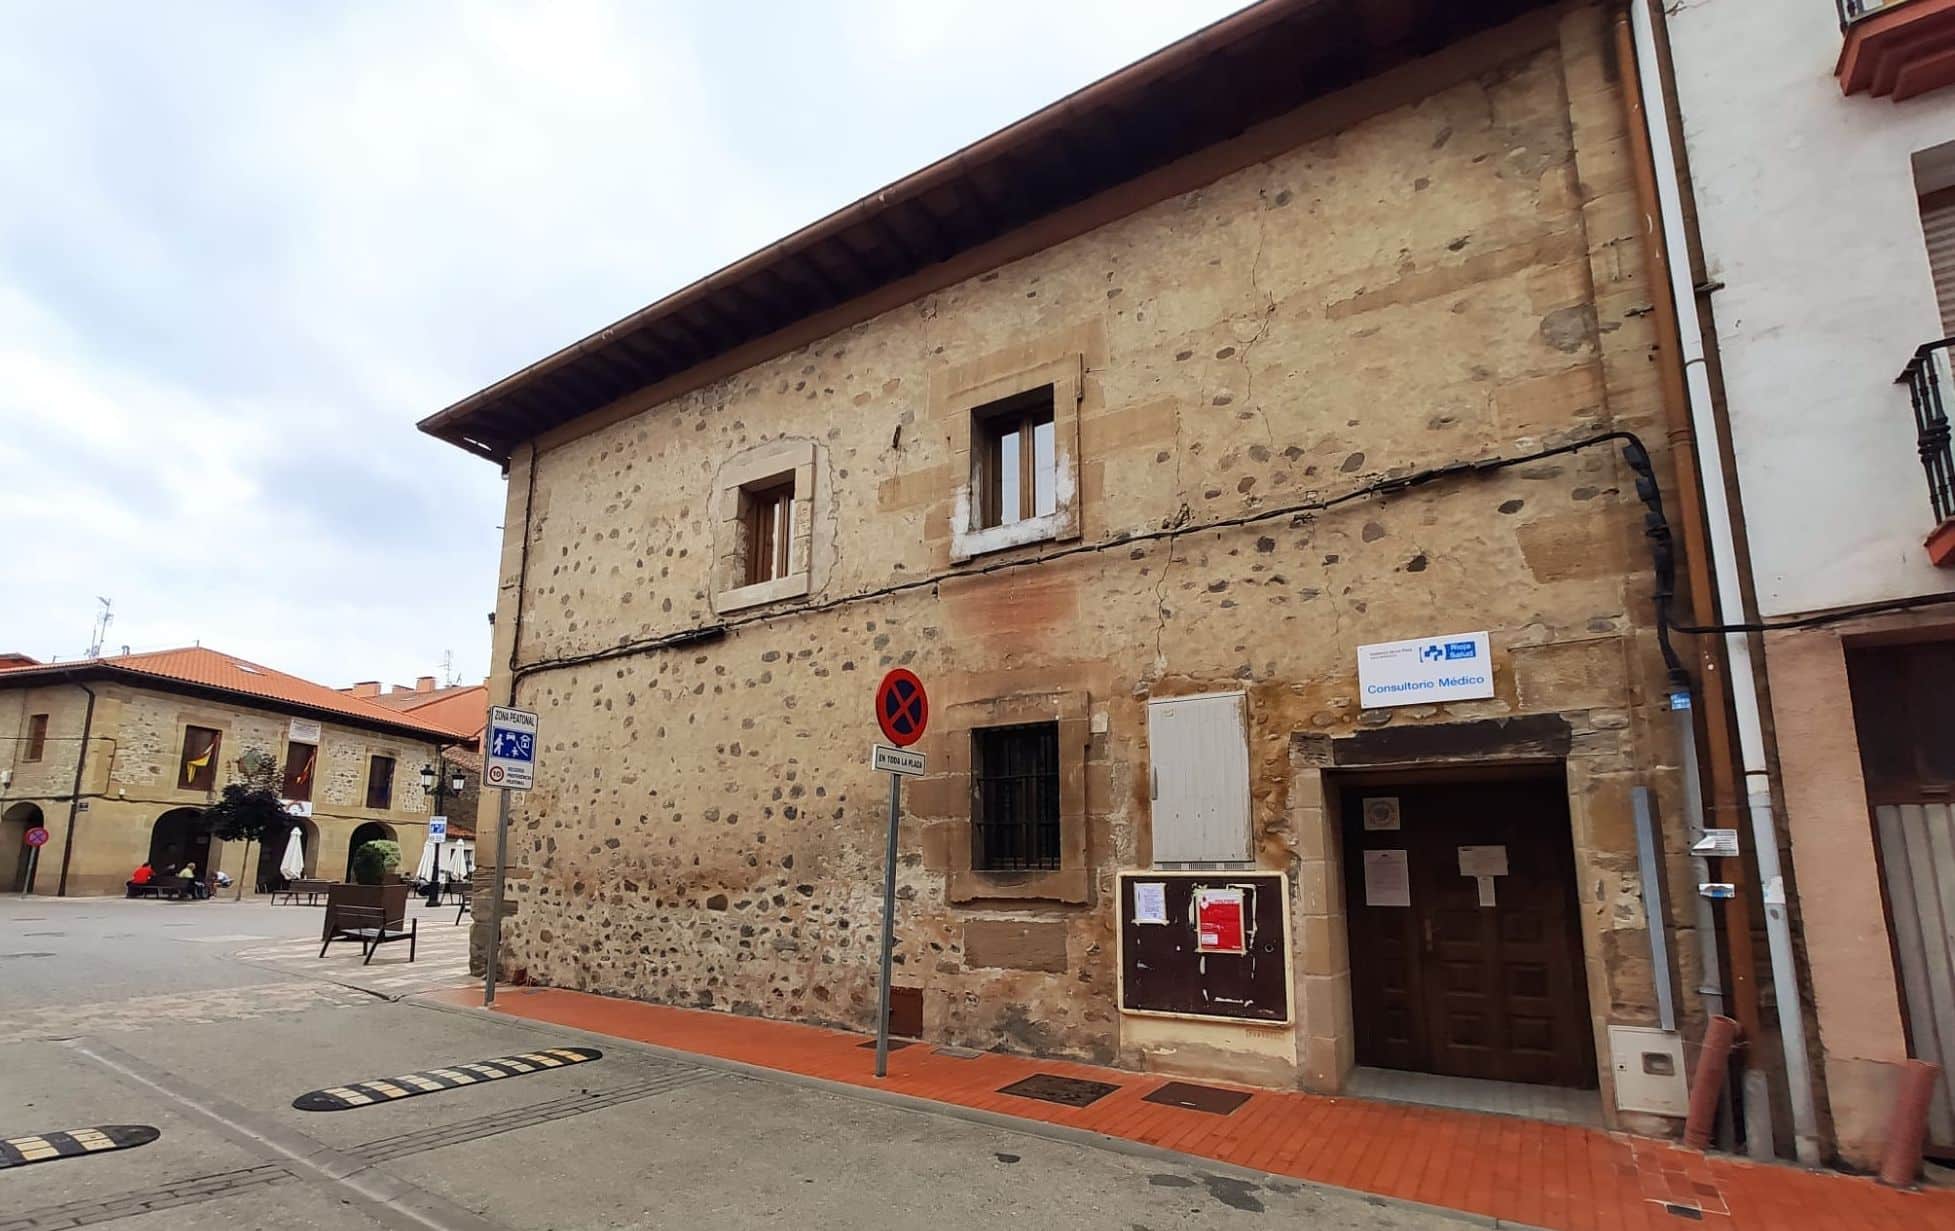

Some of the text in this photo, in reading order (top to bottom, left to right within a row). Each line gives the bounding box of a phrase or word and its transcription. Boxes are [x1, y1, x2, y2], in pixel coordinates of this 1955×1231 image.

[1367, 675, 1485, 694] Consultorio Médico
[494, 709, 535, 727] ZONA PEATONAL
[879, 753, 922, 769] EN TODA LA PLAZA
[493, 770, 502, 778] 10
